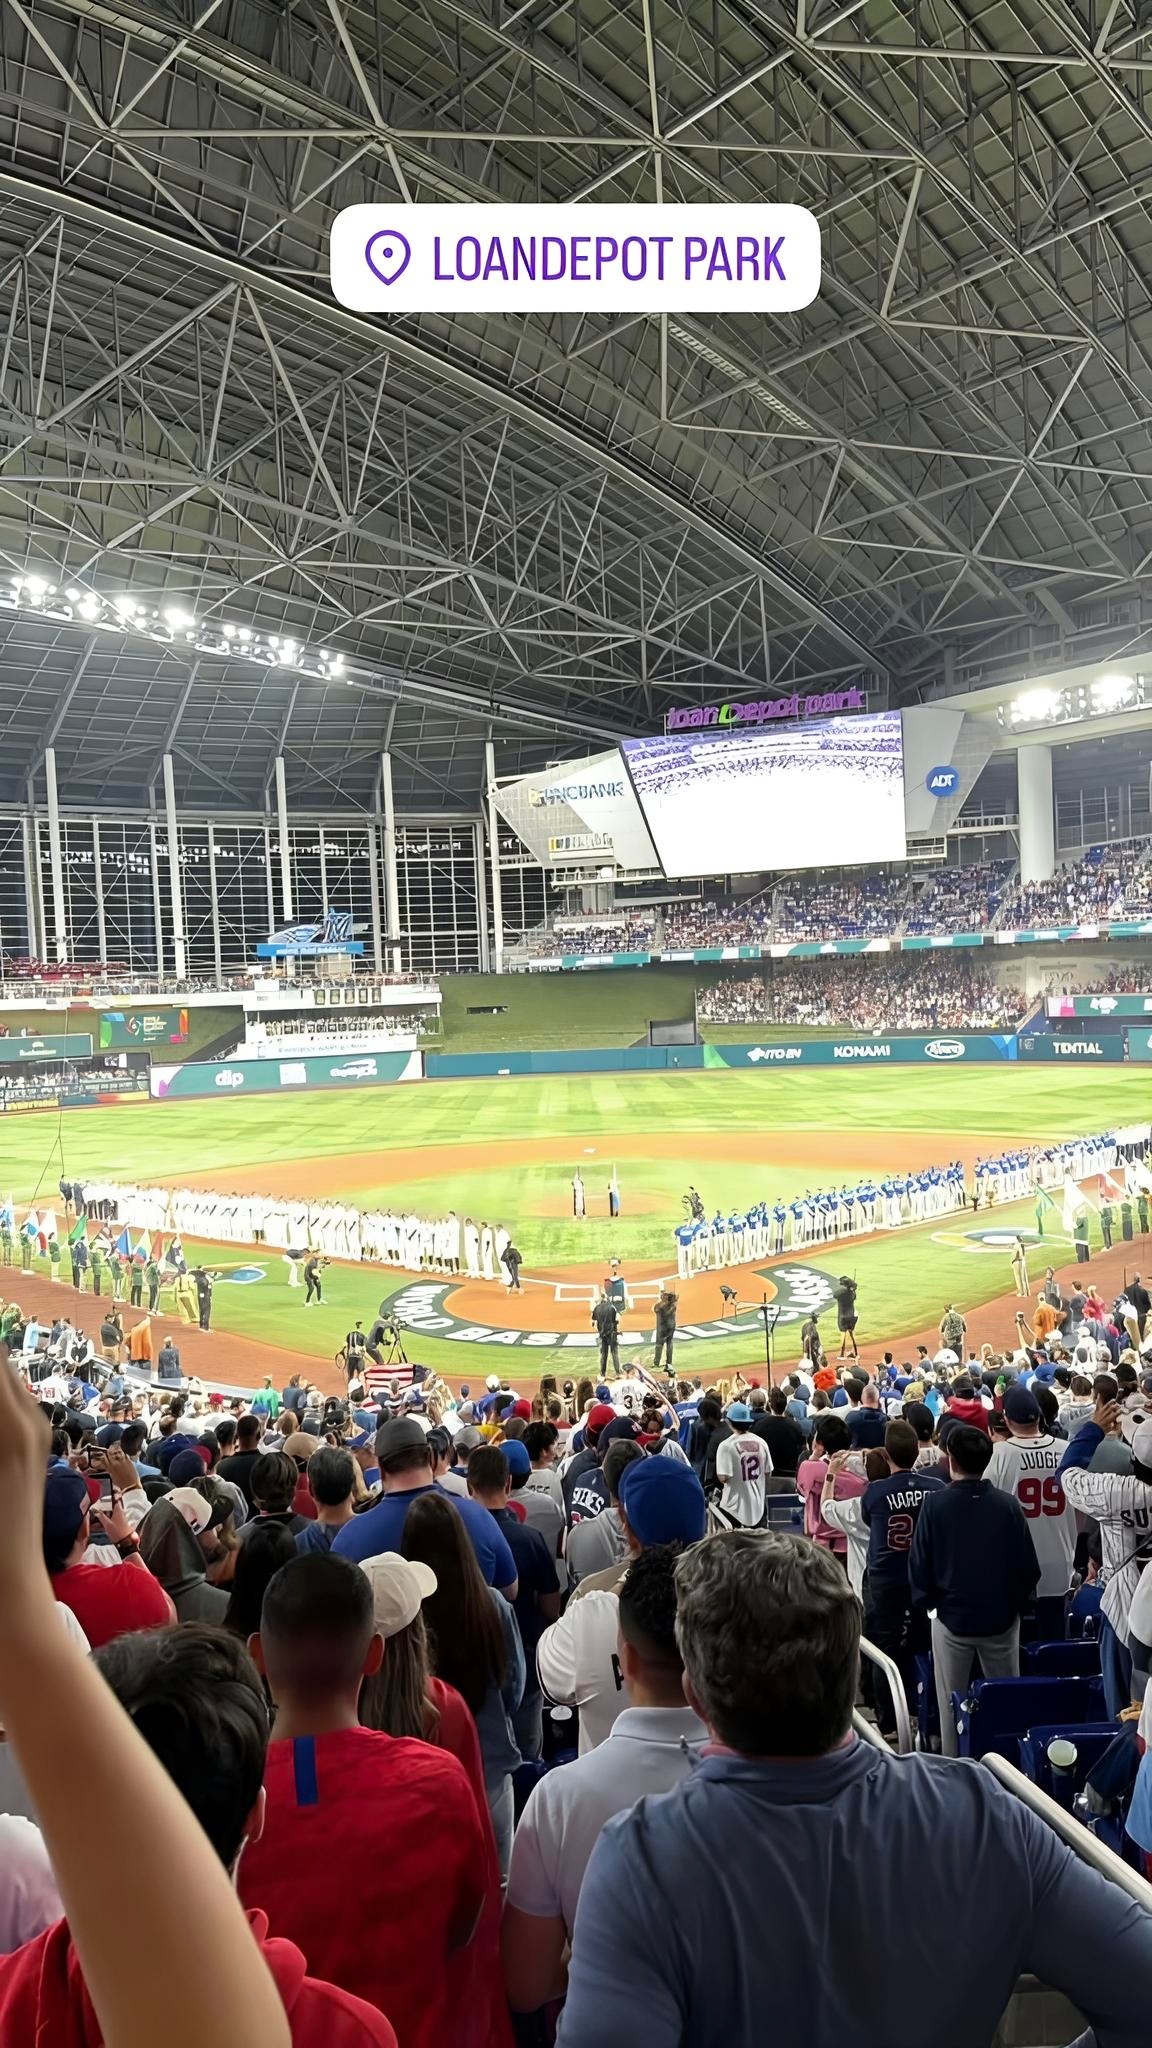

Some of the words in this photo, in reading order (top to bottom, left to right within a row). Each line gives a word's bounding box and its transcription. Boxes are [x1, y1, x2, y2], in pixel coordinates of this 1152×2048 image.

[804, 686, 866, 715] park
[930, 774, 955, 788] ADT
[834, 1045, 891, 1058] KONAMI
[392, 1284, 455, 1330] WORLD
[740, 1455, 760, 1481] 12
[1017, 1476, 1067, 1518] 99
